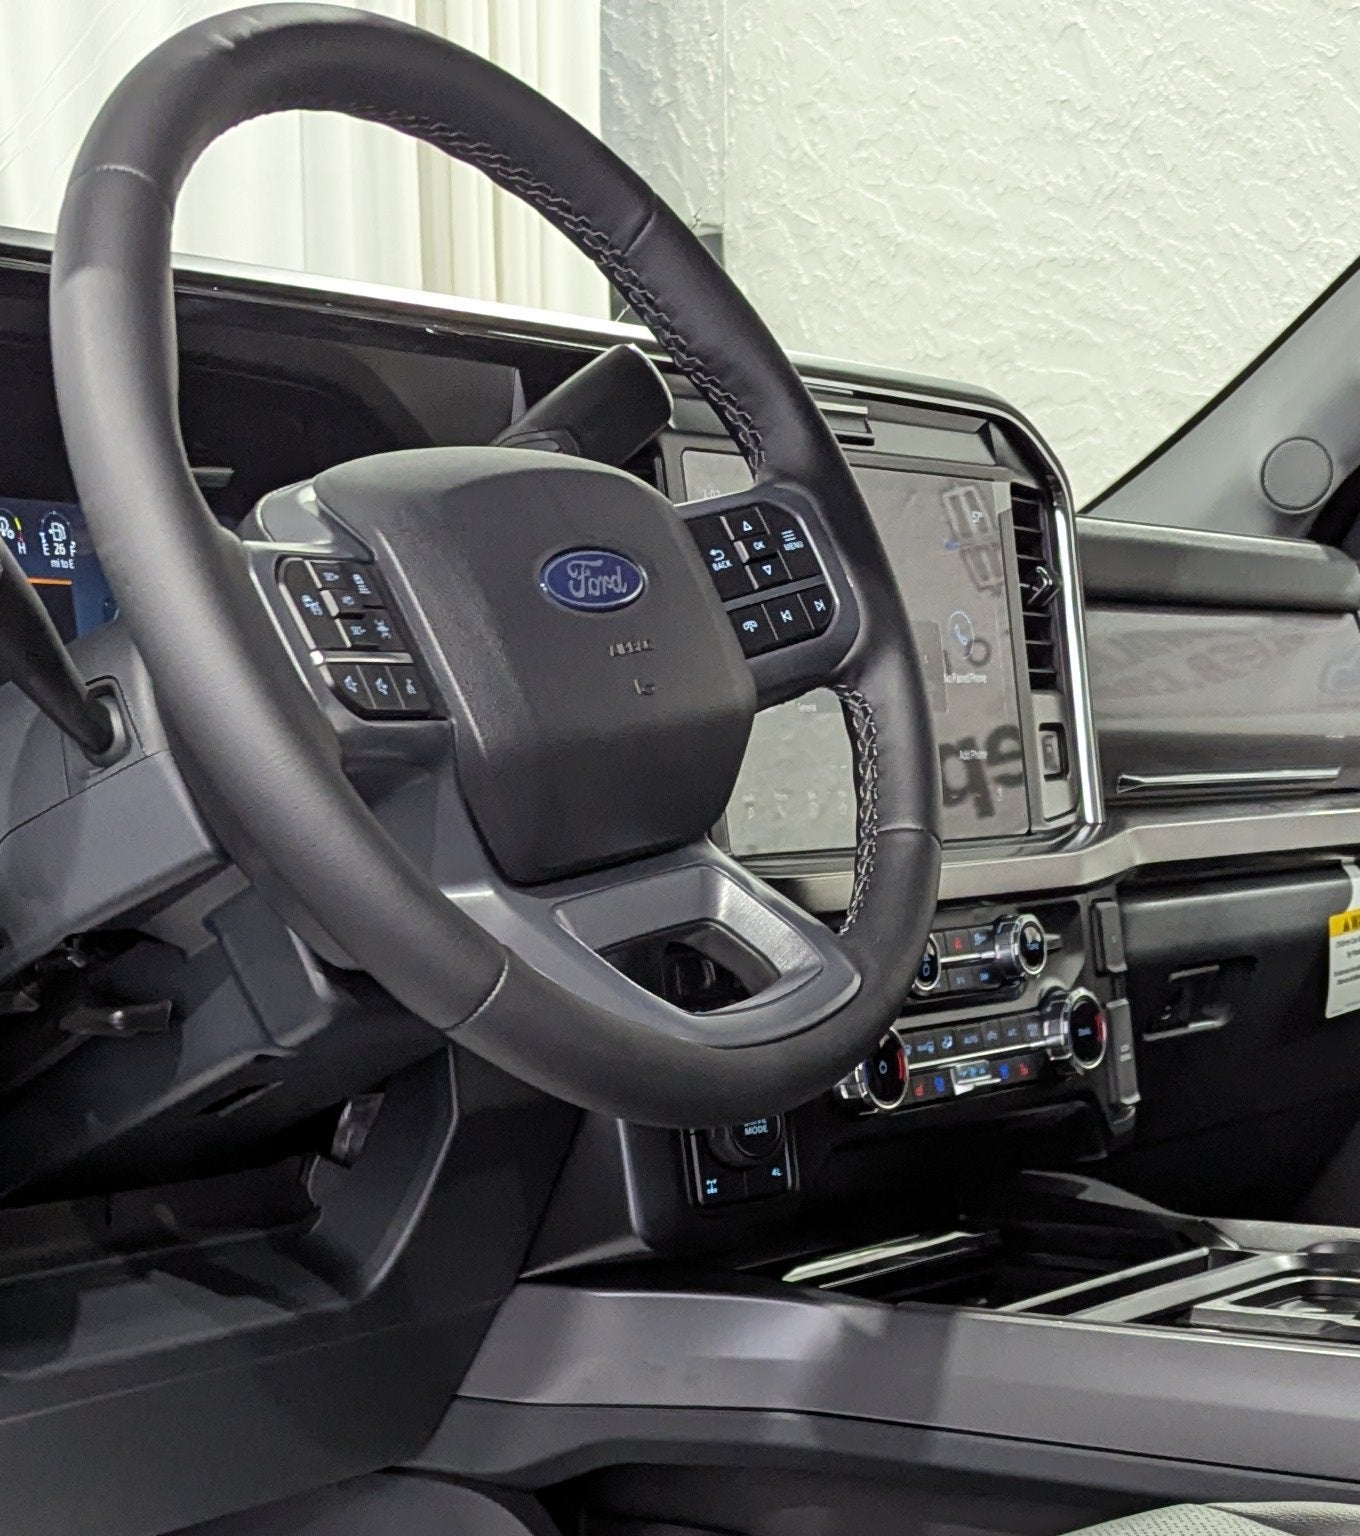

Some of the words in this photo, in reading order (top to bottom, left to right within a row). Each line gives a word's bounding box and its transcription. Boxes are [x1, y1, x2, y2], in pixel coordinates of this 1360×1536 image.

[17, 541, 27, 555] H
[42, 543, 50, 556] E
[53, 542, 66, 556] 26
[752, 540, 766, 550] OK
[783, 540, 804, 551] MENU
[711, 559, 733, 572] BACK
[566, 560, 628, 598] Ford
[744, 1124, 768, 1136] MODE
